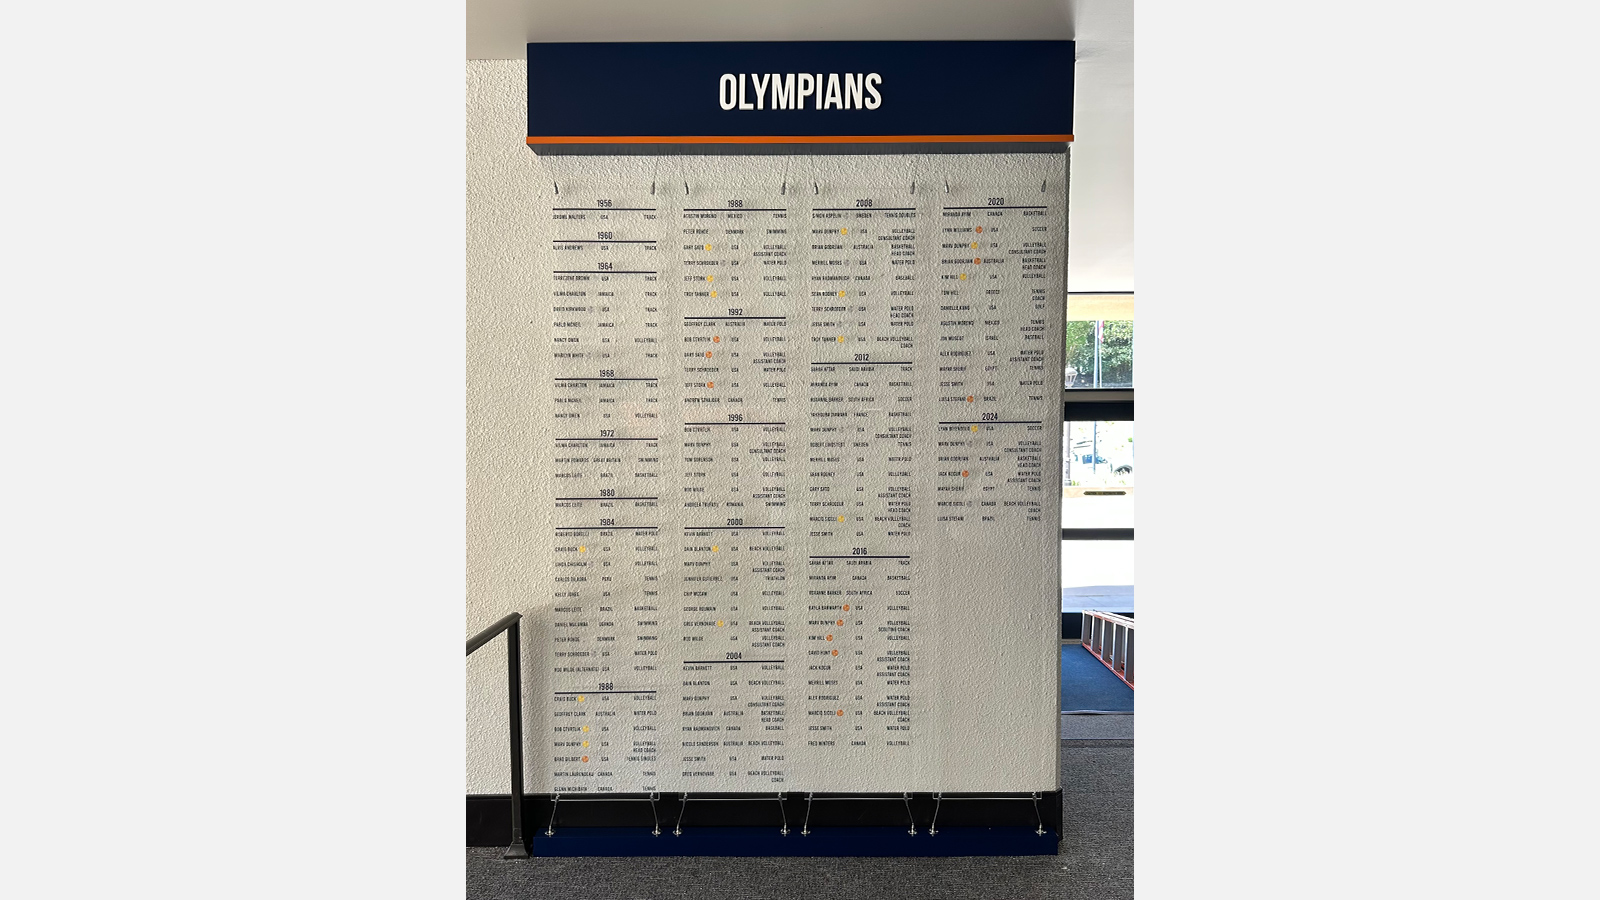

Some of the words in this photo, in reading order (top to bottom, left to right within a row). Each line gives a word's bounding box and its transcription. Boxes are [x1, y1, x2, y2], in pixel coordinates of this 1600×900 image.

[719, 73, 882, 110] OLYMPIANS
[597, 199, 612, 207] 1956
[728, 200, 743, 208] 1988
[856, 199, 873, 207] 2008
[988, 198, 1004, 206] 2020
[597, 232, 612, 240] 1960
[598, 262, 613, 270] 1964
[728, 308, 743, 316] 1992
[599, 369, 614, 377] 1968
[982, 412, 998, 420] 2024
[600, 429, 614, 437] 1972
[600, 489, 615, 497] 1980
[727, 518, 743, 526] 2000
[853, 547, 867, 555] 2016
[726, 652, 742, 660] 2004
